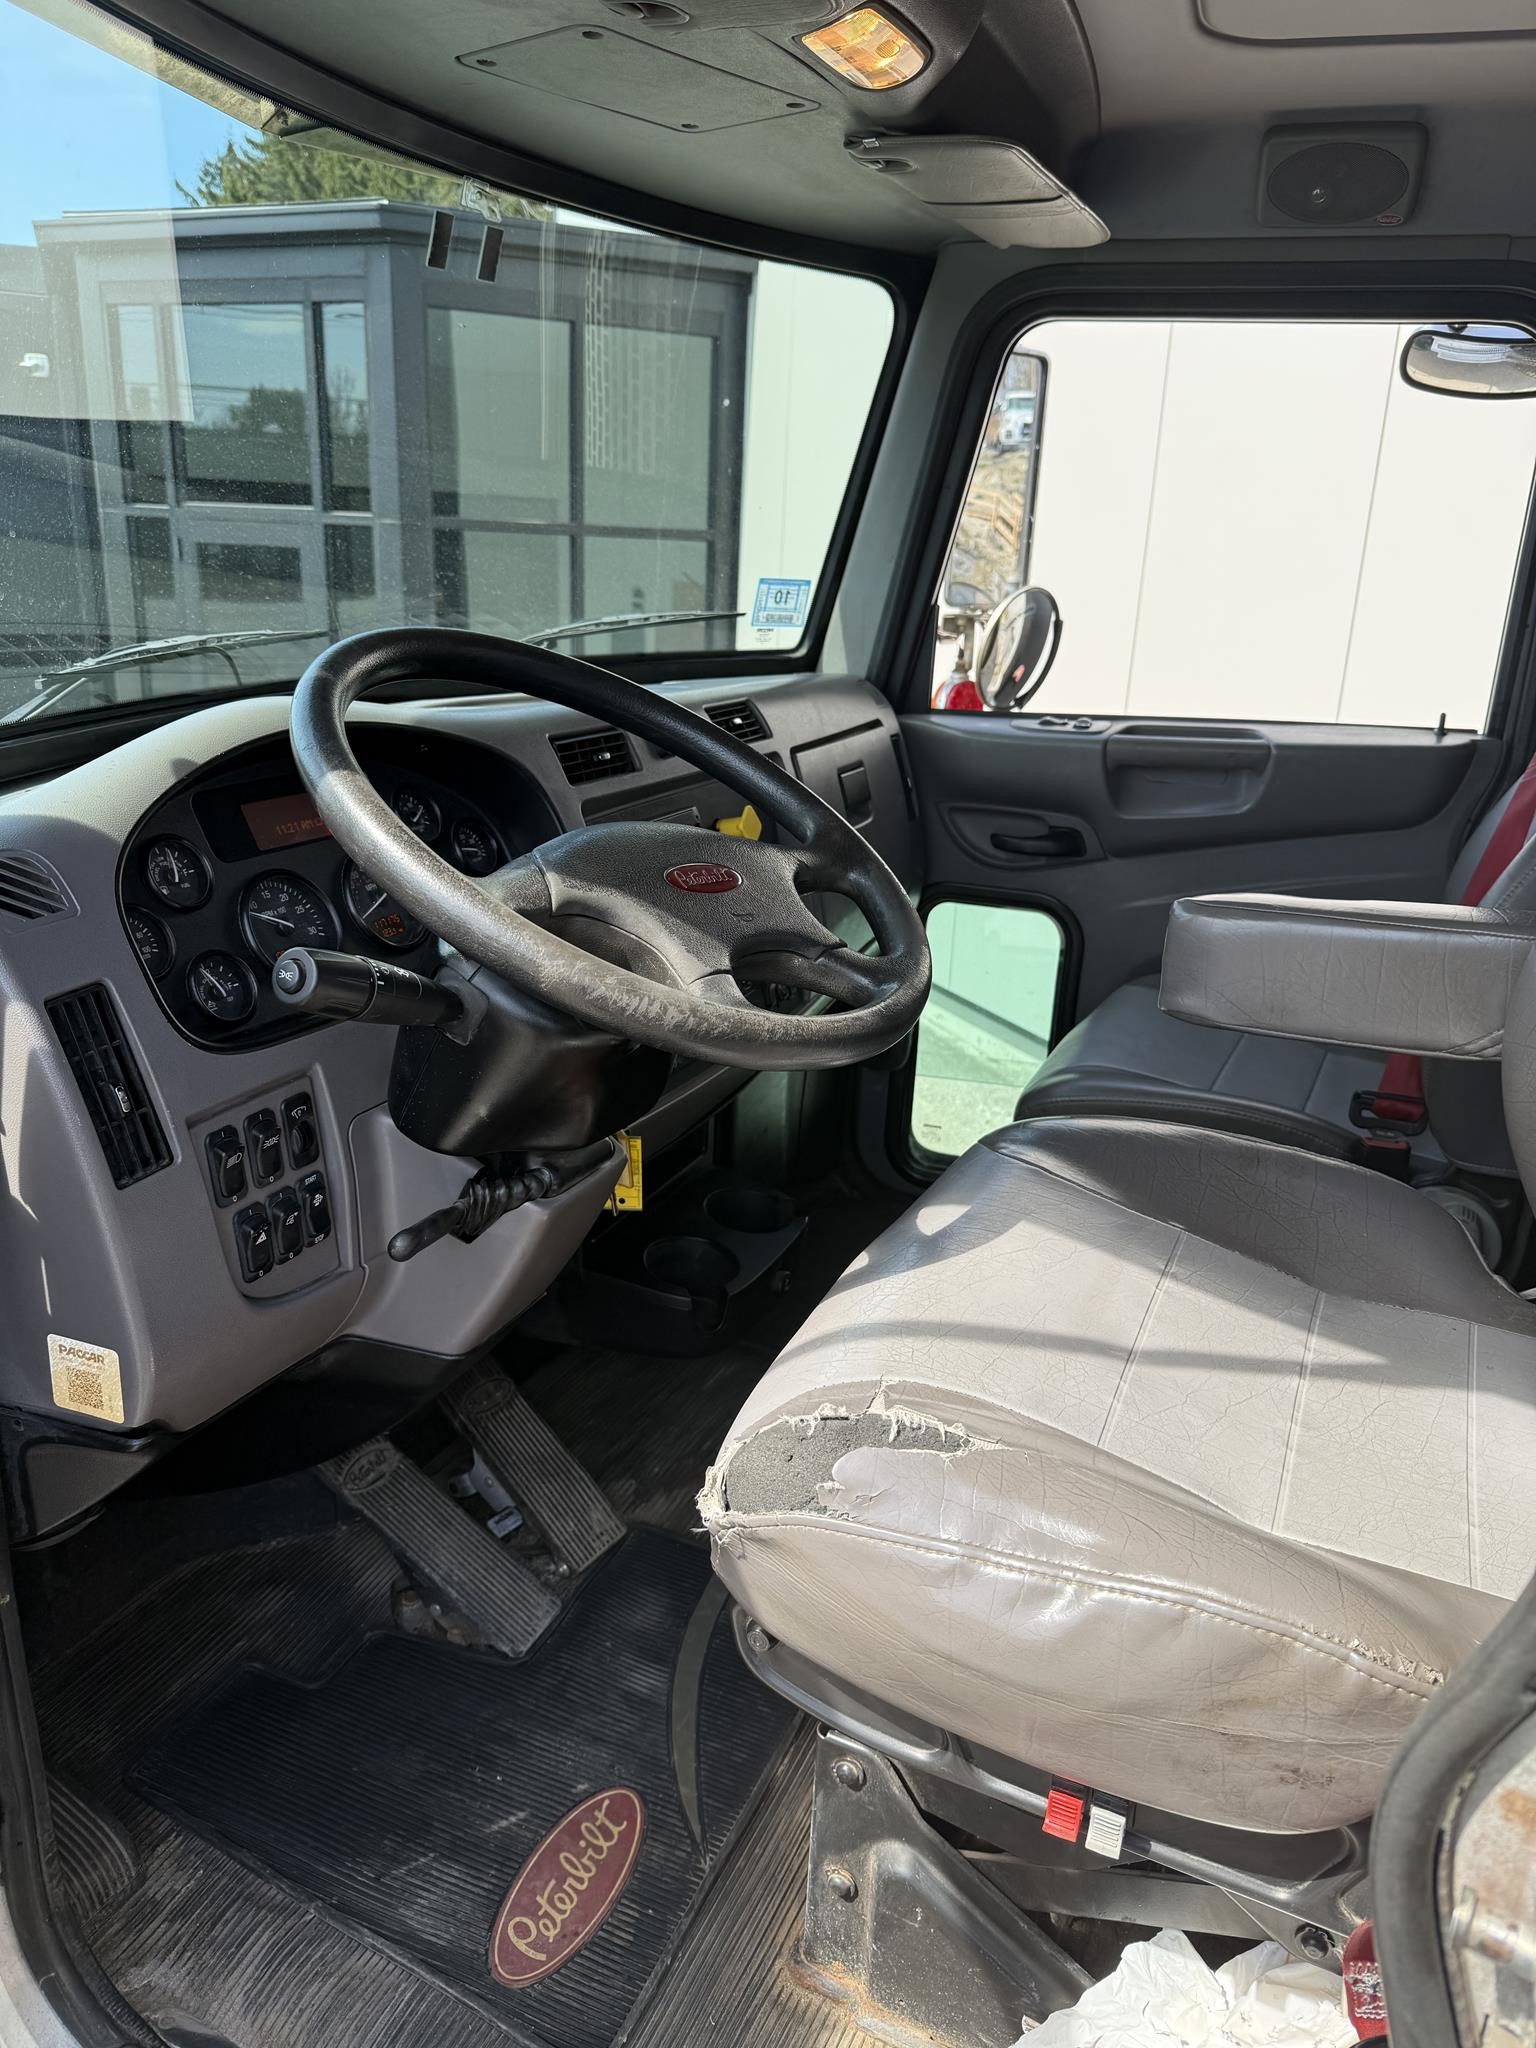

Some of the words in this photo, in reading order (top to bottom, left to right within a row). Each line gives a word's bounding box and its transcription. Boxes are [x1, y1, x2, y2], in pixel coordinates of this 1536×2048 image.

[673, 867, 734, 889] Peterbilt
[261, 890, 271, 899] 15
[279, 892, 289, 902] 20
[294, 904, 305, 914] 25
[306, 925, 318, 936] 30
[58, 1343, 105, 1365] PACCAR
[508, 1799, 627, 1961] Peterbilt
